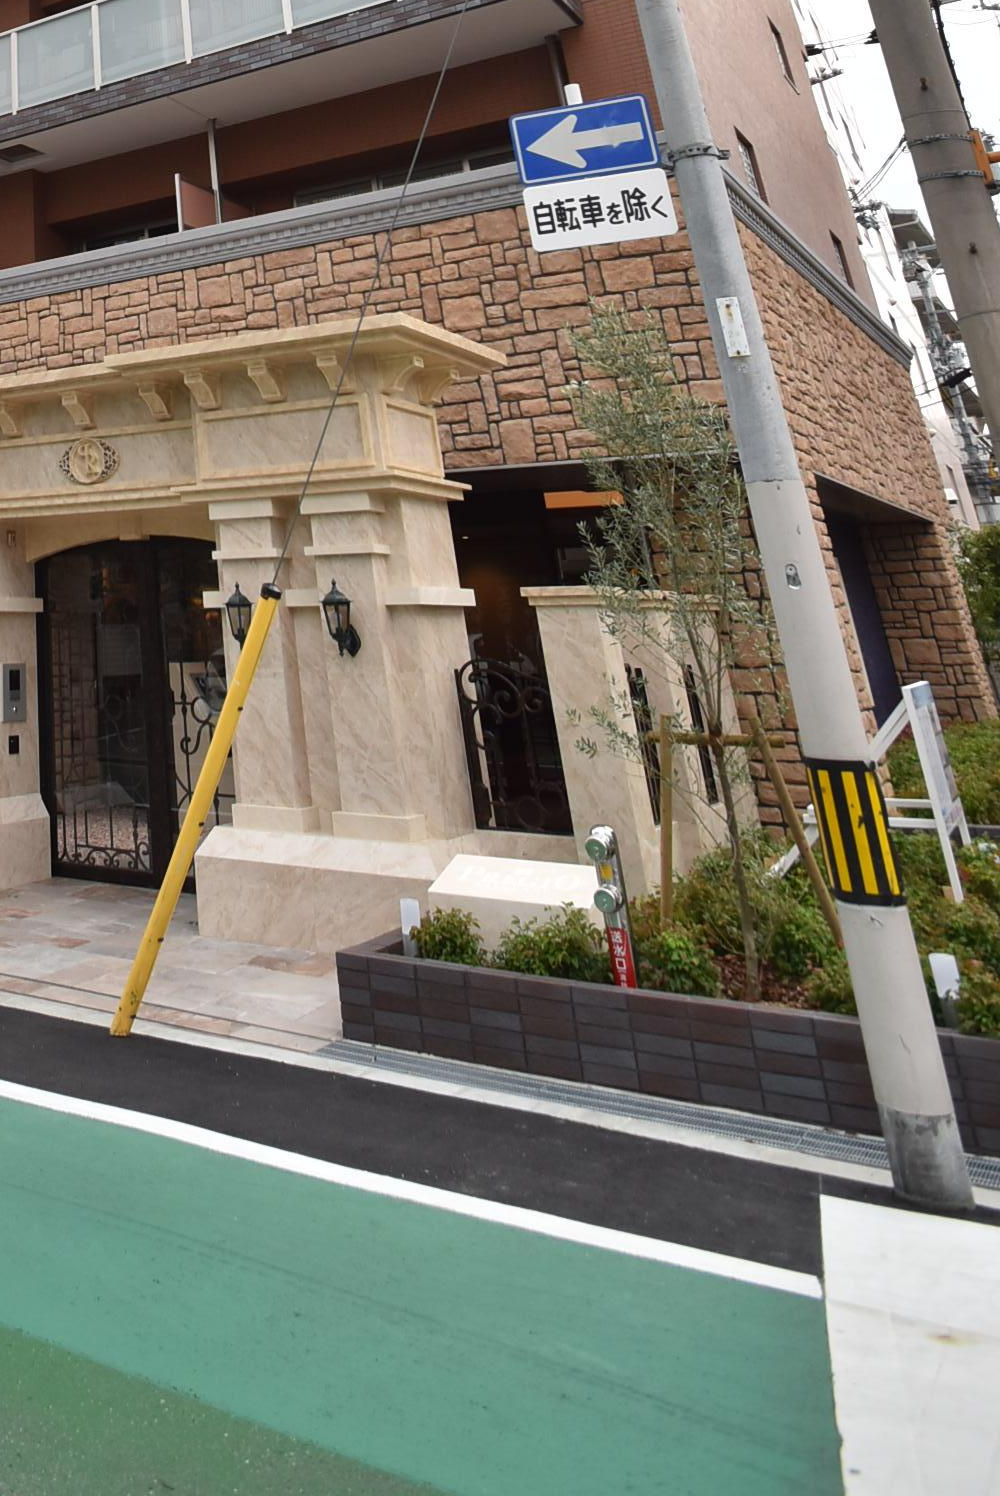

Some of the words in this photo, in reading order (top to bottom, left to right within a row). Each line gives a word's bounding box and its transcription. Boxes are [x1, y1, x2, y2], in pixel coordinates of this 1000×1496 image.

[533, 188, 668, 235] 自転車を除く
